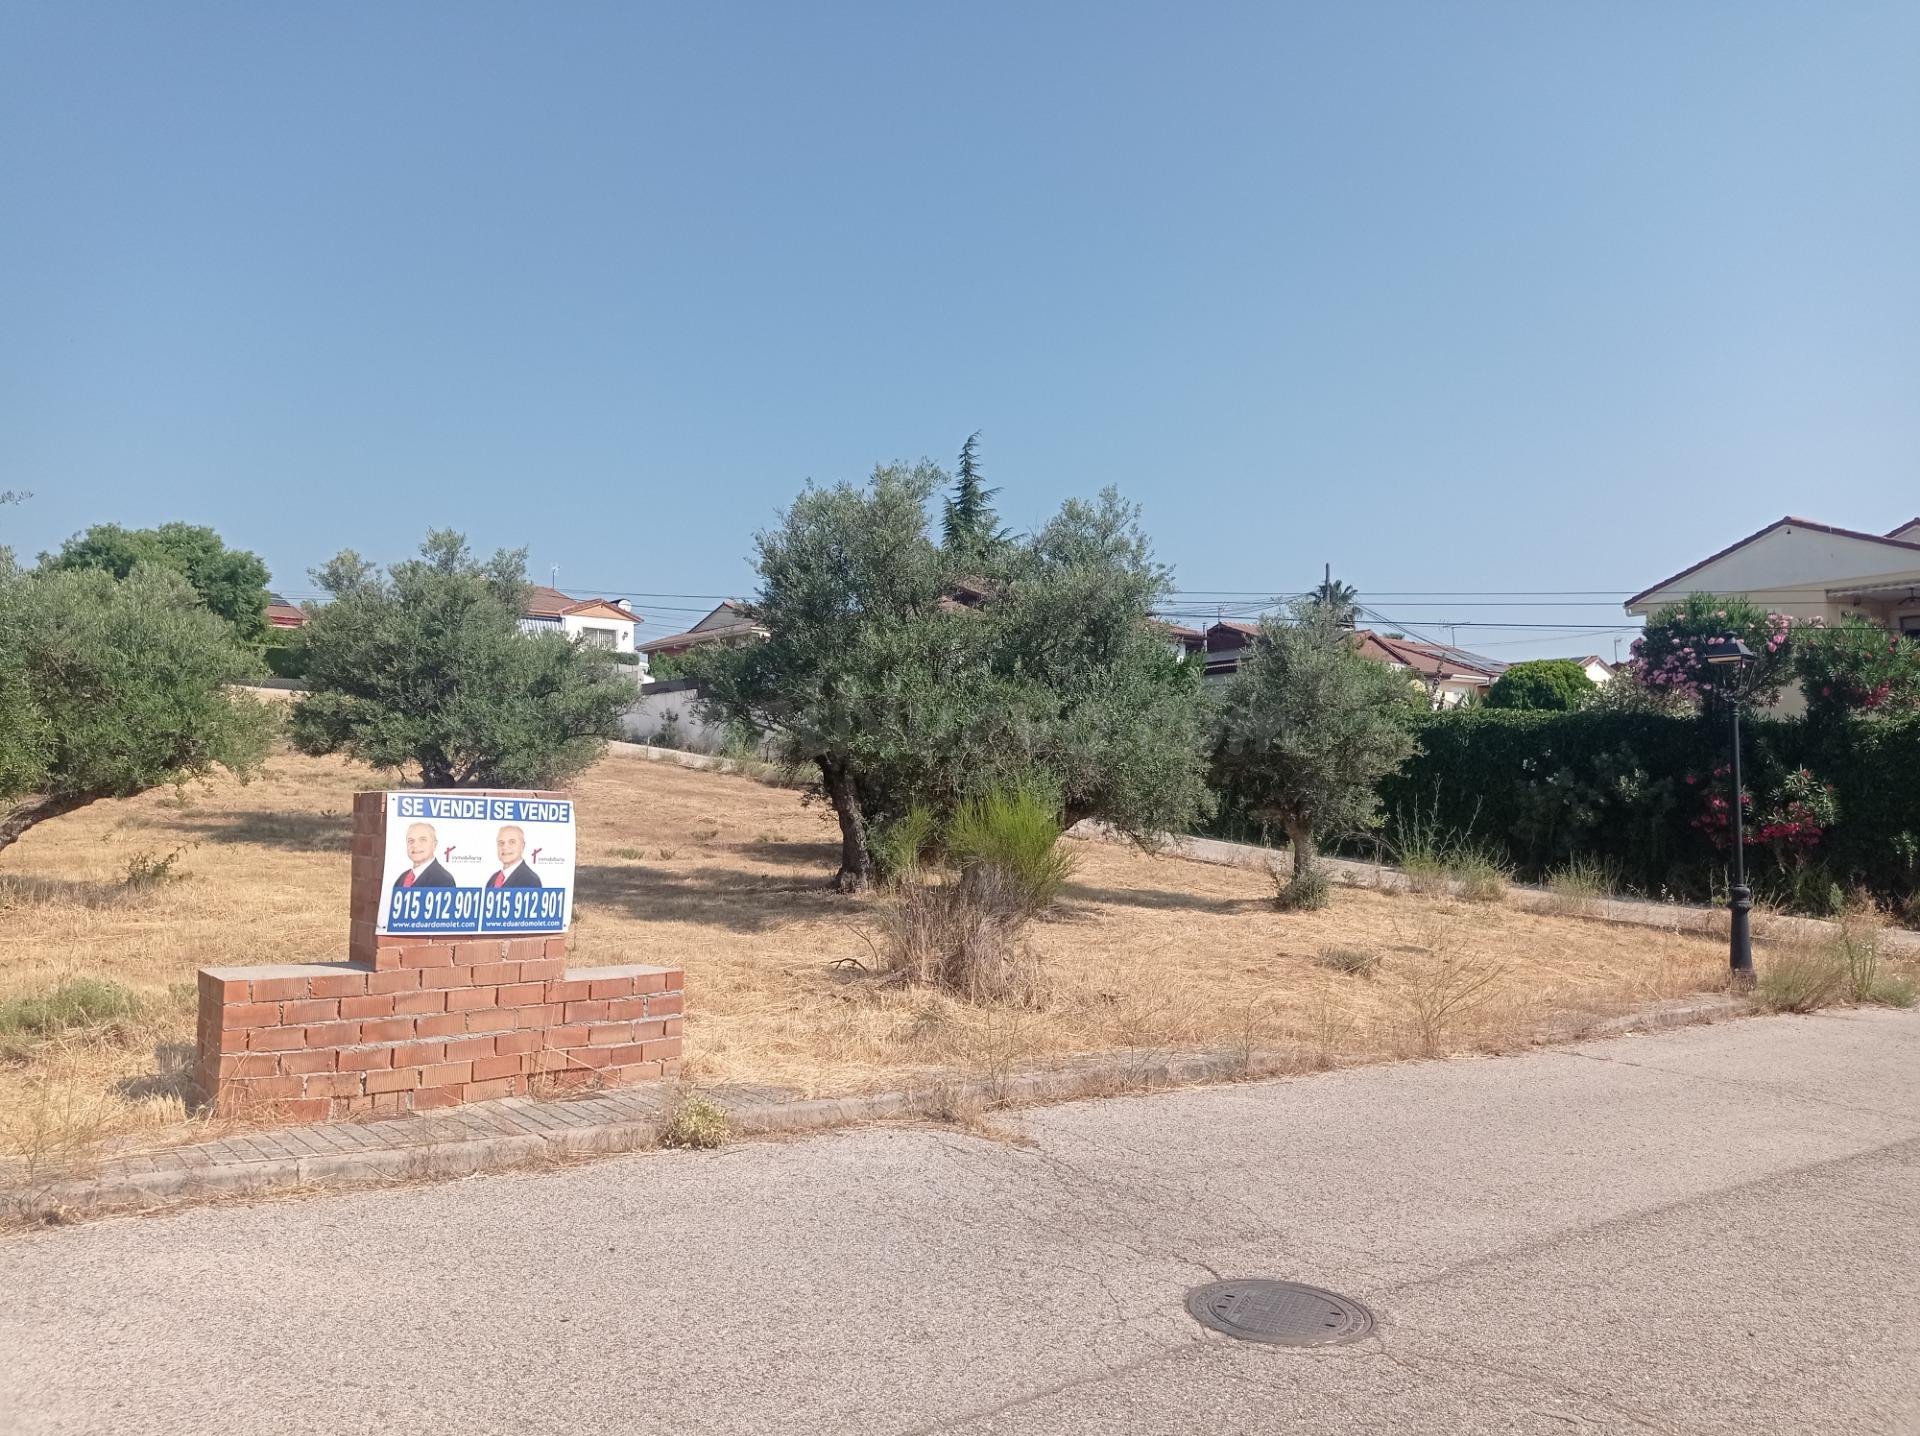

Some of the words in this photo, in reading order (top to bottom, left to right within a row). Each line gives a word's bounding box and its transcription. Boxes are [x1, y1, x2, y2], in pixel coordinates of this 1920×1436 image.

[402, 798, 424, 816] SE
[429, 799, 485, 818] VENDE
[493, 801, 515, 819] SE
[519, 802, 568, 822] VENDE
[392, 891, 421, 919] 915
[424, 891, 452, 919] 912
[454, 891, 479, 919] 901
[485, 891, 511, 919] 915
[514, 891, 539, 919] 912
[541, 891, 563, 918] 901
[392, 920, 475, 929] www.eduardomolet.com
[485, 919, 560, 928] www.eduardomolet.com
